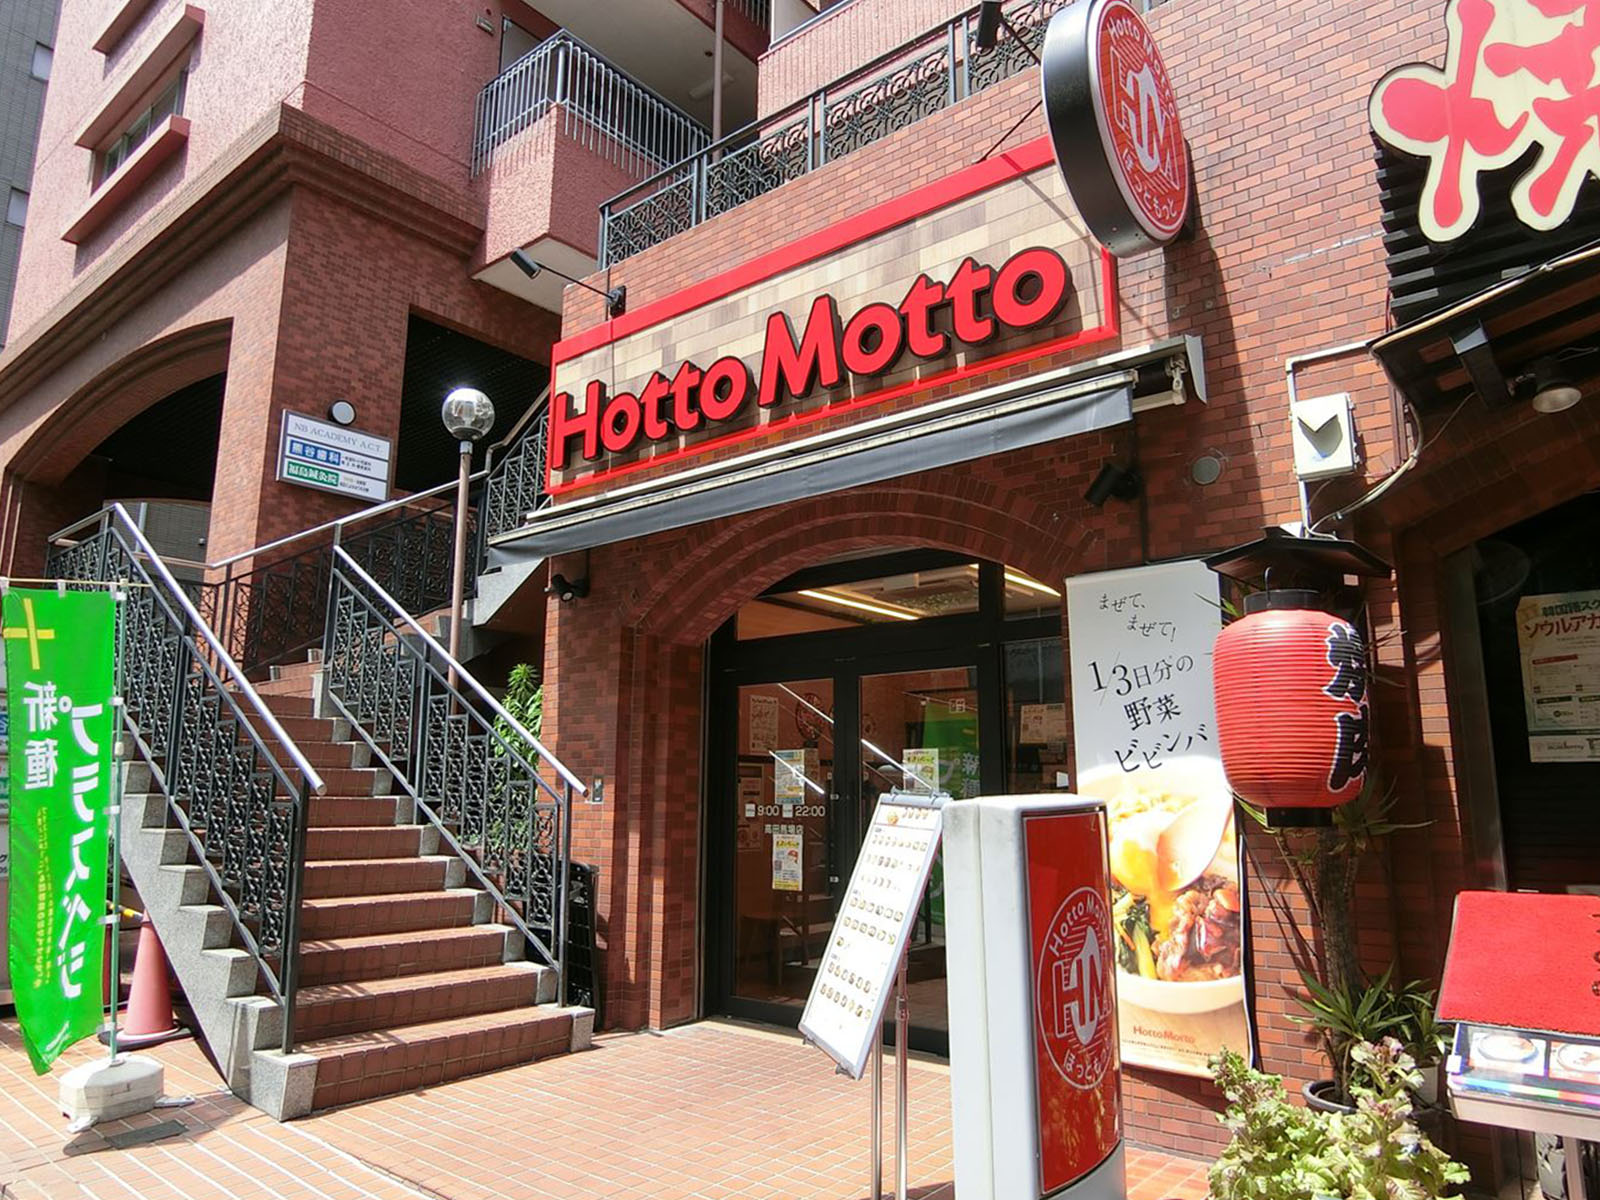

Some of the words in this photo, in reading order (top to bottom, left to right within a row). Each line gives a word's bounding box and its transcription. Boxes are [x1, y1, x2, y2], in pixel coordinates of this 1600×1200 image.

[1107, 17, 1140, 45] Hotto
[551, 354, 754, 470] Hotto
[758, 246, 1074, 410] Motto
[310, 427, 358, 447] ACADEMY
[1123, 693, 1182, 732] 野菜
[1114, 723, 1209, 773] ビビンバ
[757, 804, 780, 817] 9:00
[795, 805, 826, 817] 22:00
[1048, 901, 1085, 957] Hotto
